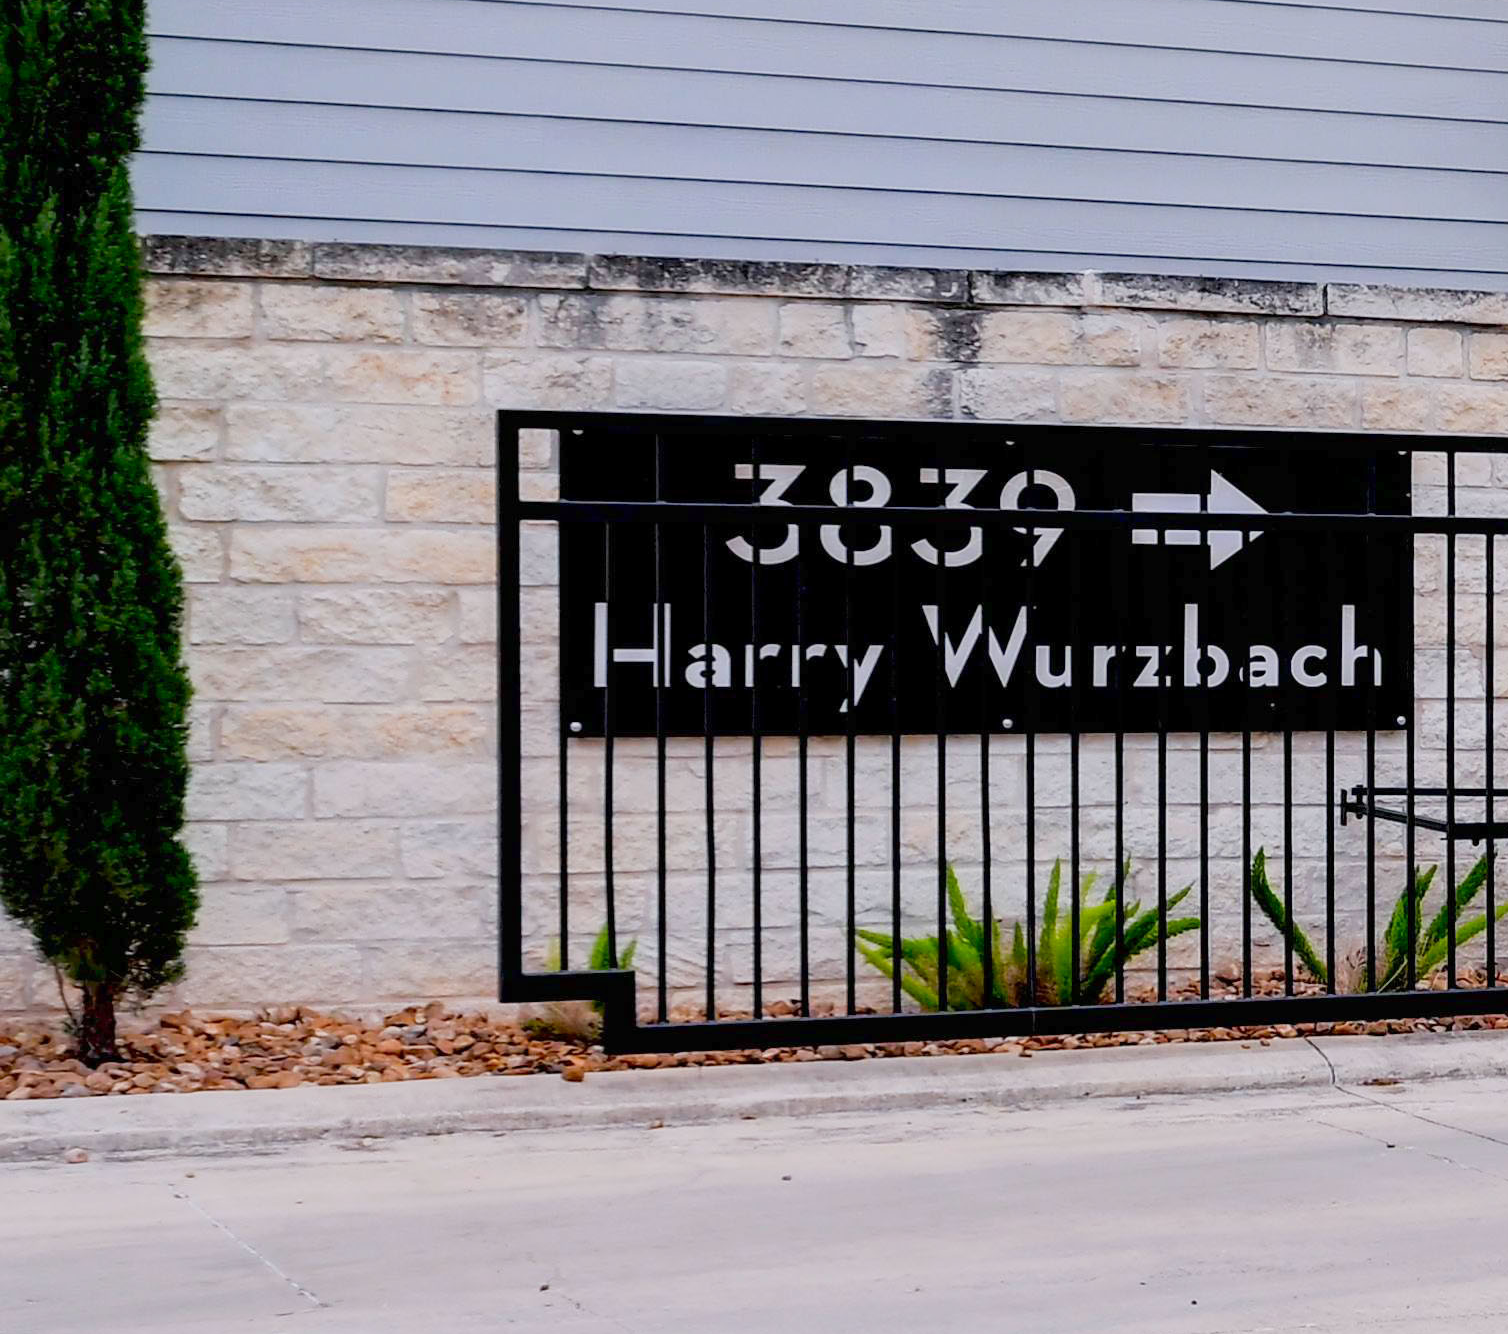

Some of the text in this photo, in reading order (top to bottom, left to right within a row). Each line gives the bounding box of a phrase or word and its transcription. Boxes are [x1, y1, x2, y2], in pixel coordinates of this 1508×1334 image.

[725, 463, 1077, 568] 3839
[593, 602, 1384, 714] Harry Wurzbach
